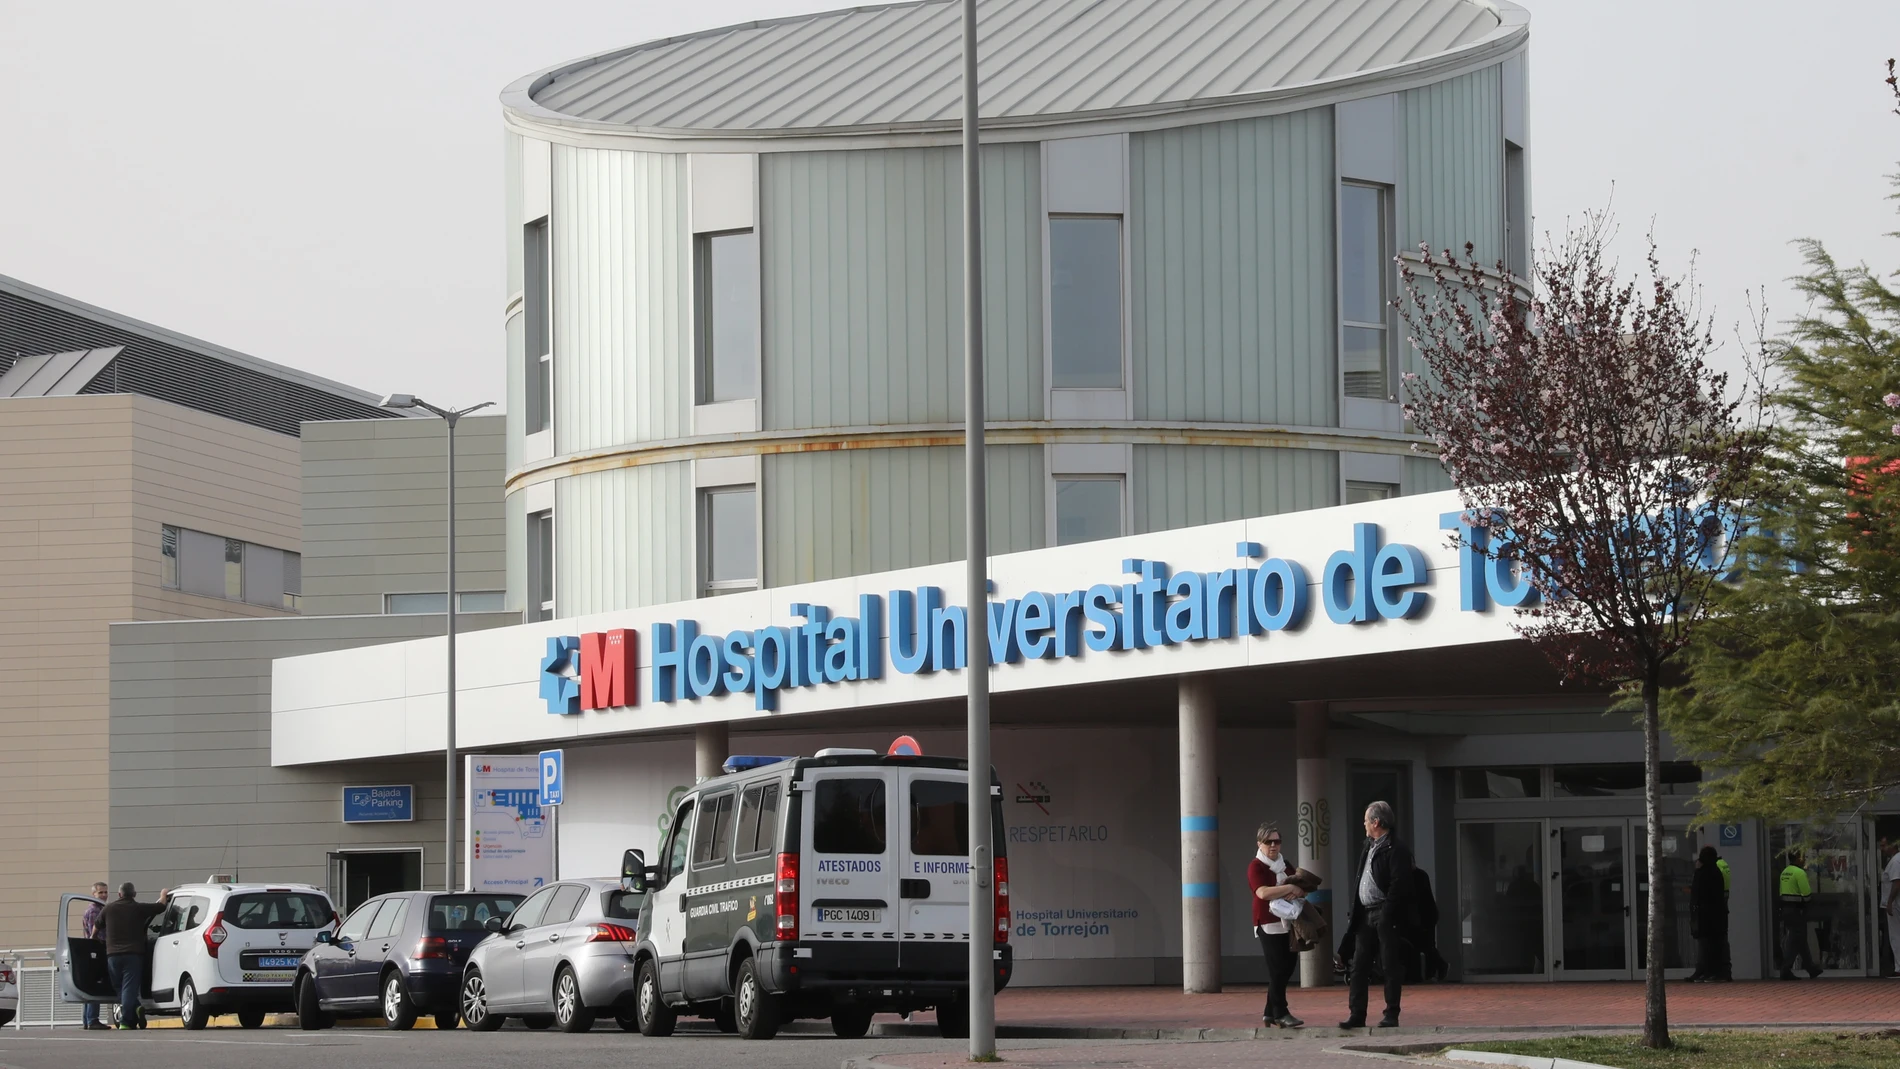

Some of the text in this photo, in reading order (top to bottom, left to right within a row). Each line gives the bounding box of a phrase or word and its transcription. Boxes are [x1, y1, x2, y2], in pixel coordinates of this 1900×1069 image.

[580, 628, 636, 710] M
[652, 594, 881, 710] Hospital
[889, 542, 1307, 674] Unversitario
[1323, 522, 1428, 624] de
[493, 766, 515, 774] Hospital
[543, 757, 557, 799] P
[371, 789, 401, 799] Bajada
[549, 790, 559, 798] TAXI
[371, 799, 403, 808] Parking
[1010, 825, 1108, 842] RESPETARLO
[818, 860, 881, 872] ATESTADOS
[914, 862, 920, 872] E
[690, 906, 708, 918] GUARDIA
[709, 903, 719, 914] CIVIL
[824, 909, 843, 921] PGC
[846, 909, 870, 921] 1409
[1016, 909, 1138, 921] Hospital Universitario
[1016, 921, 1110, 938] de Torrejón
[265, 957, 286, 966] 4925
